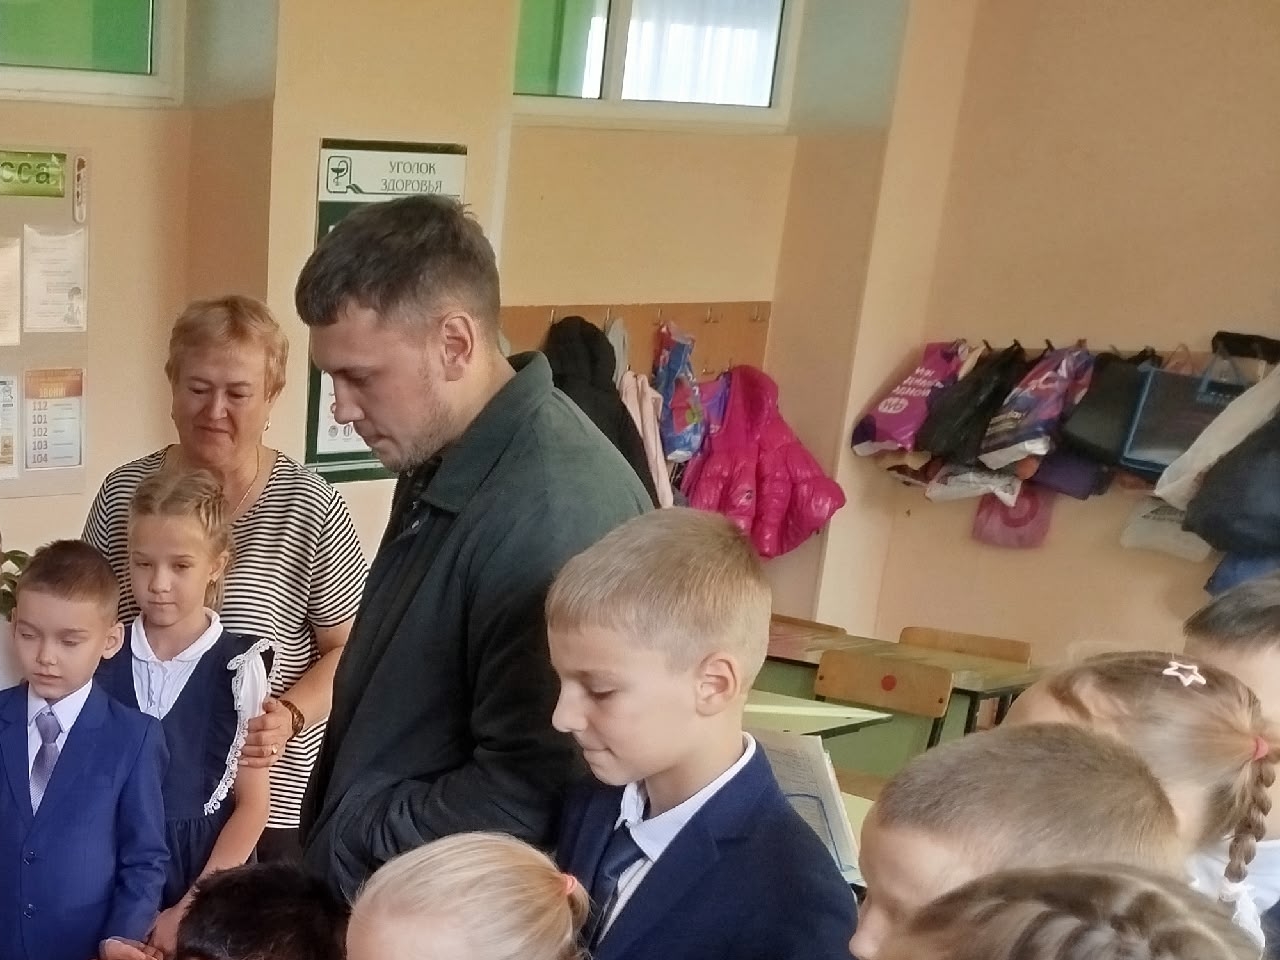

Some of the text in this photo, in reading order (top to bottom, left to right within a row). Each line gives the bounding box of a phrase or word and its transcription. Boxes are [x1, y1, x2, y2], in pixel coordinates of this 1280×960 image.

[389, 160, 436, 175] УГОЛОК
[380, 178, 442, 193] ЗДОРОВЬЯ
[32, 401, 48, 411] 112
[32, 414, 48, 425] 101
[32, 427, 48, 437] 102
[32, 440, 48, 451] 103
[32, 453, 48, 464] 104
